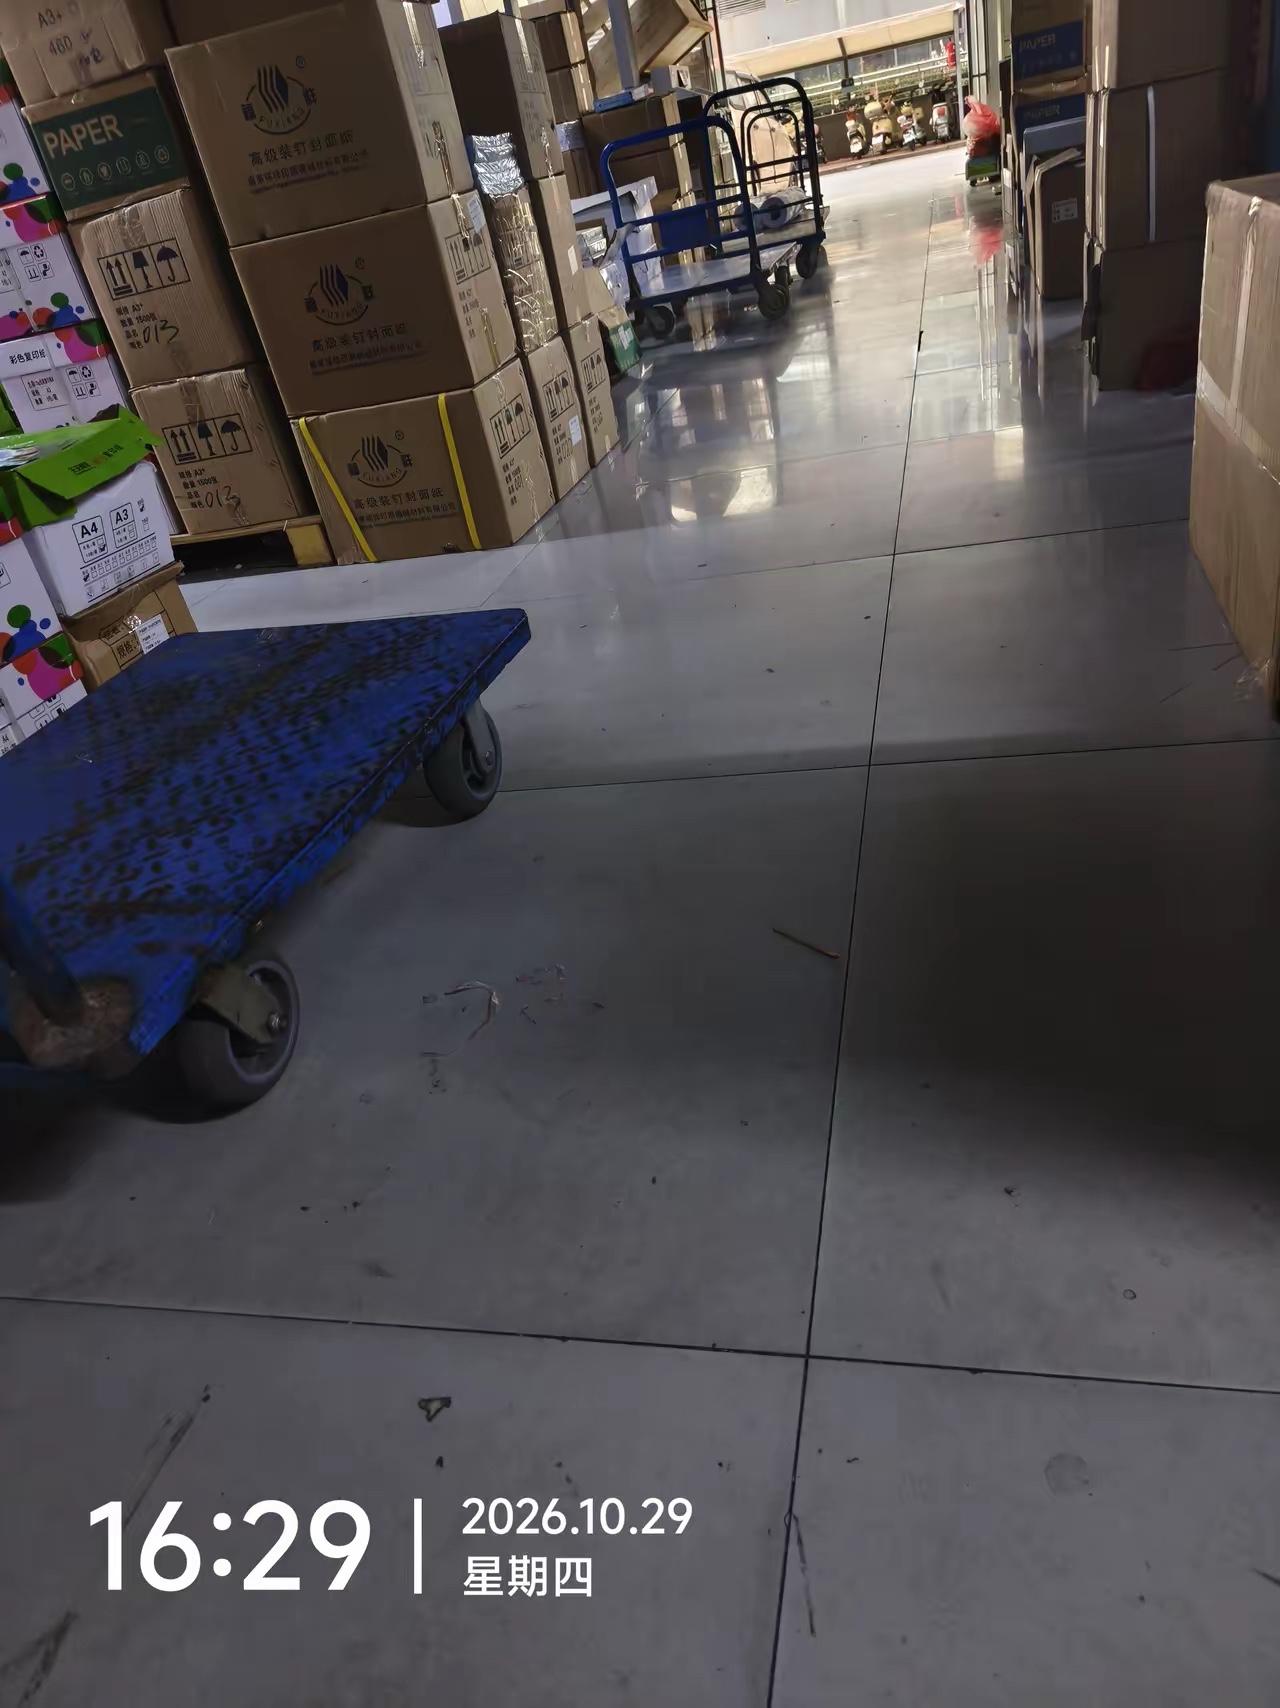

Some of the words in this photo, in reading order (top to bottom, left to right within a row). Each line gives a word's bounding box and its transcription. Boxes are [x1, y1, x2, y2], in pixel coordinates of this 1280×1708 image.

[1019, 33, 1056, 52] PAPER
[43, 114, 124, 159] PAPER
[9, 348, 46, 365] 彩色复印纸
[354, 488, 444, 509] 高级装订封面纸
[115, 509, 129, 524] A3
[81, 522, 98, 539] A4
